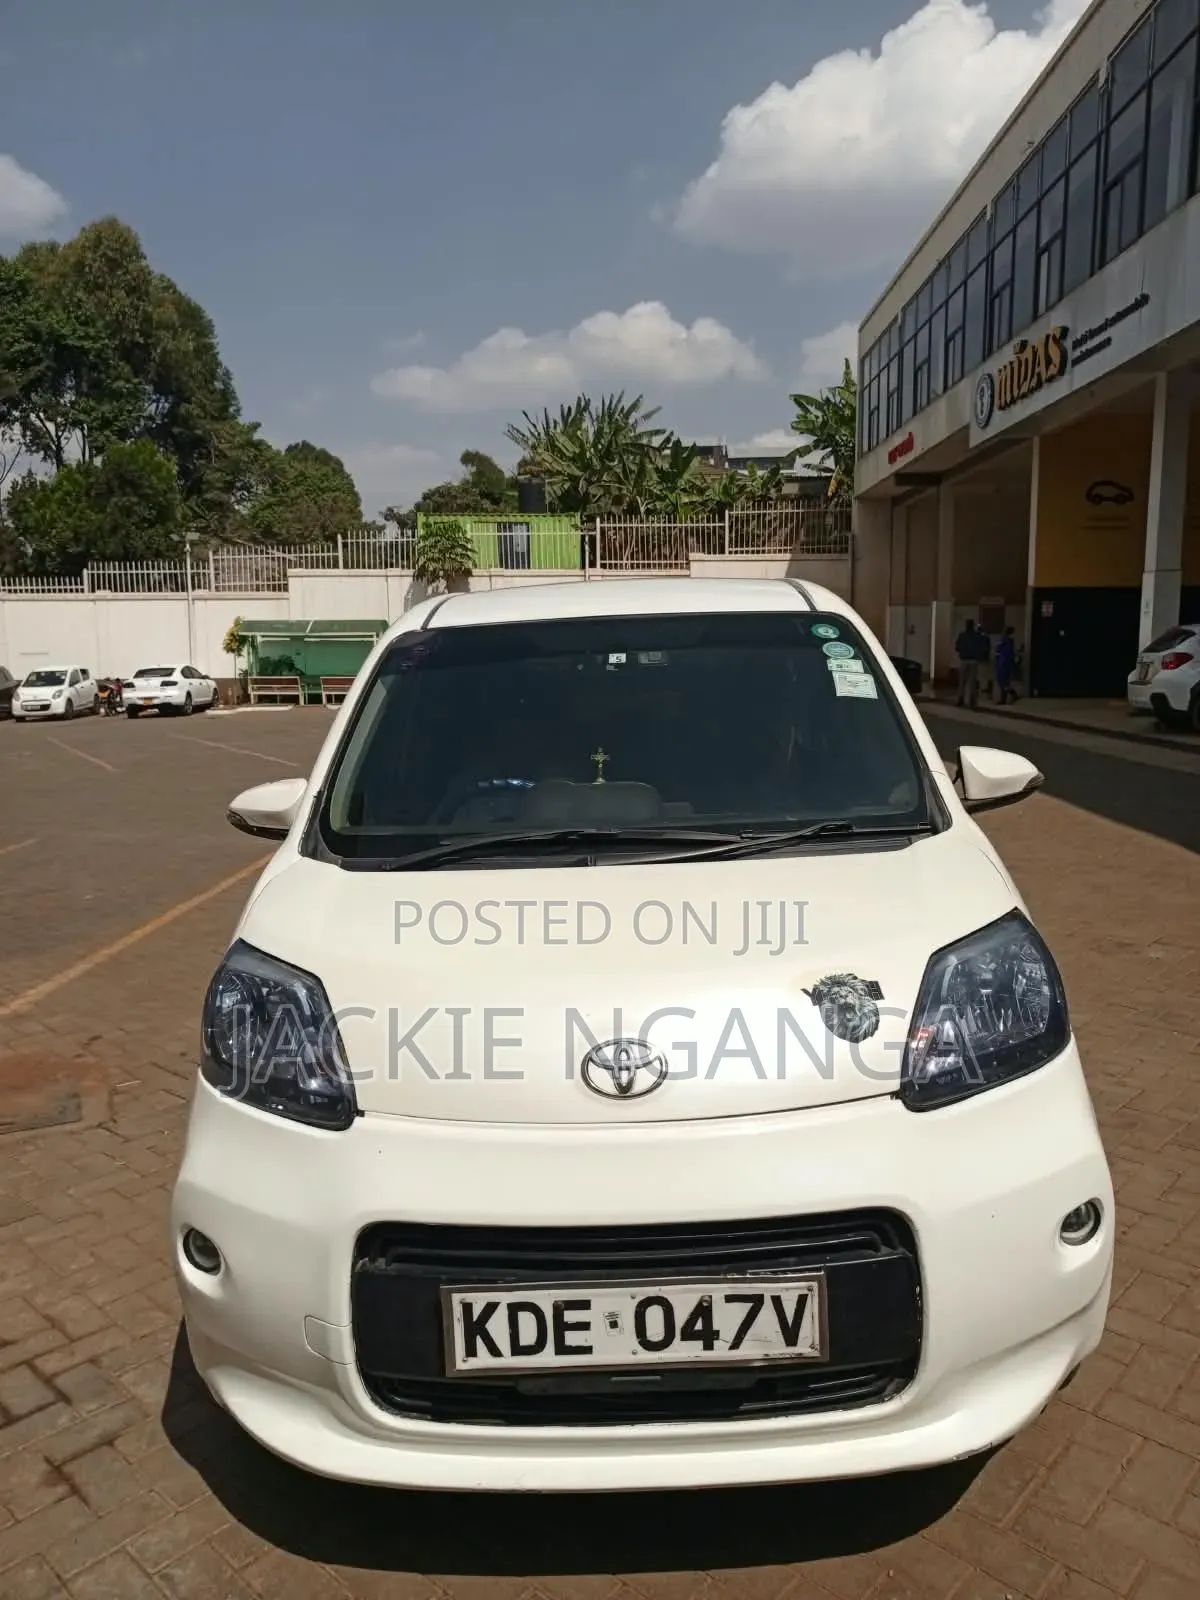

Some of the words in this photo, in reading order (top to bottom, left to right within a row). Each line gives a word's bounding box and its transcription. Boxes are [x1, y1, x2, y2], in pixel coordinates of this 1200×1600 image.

[995, 325, 1069, 410] MIDAS
[461, 1299, 593, 1358] KDE
[634, 1293, 810, 1353] 047V
